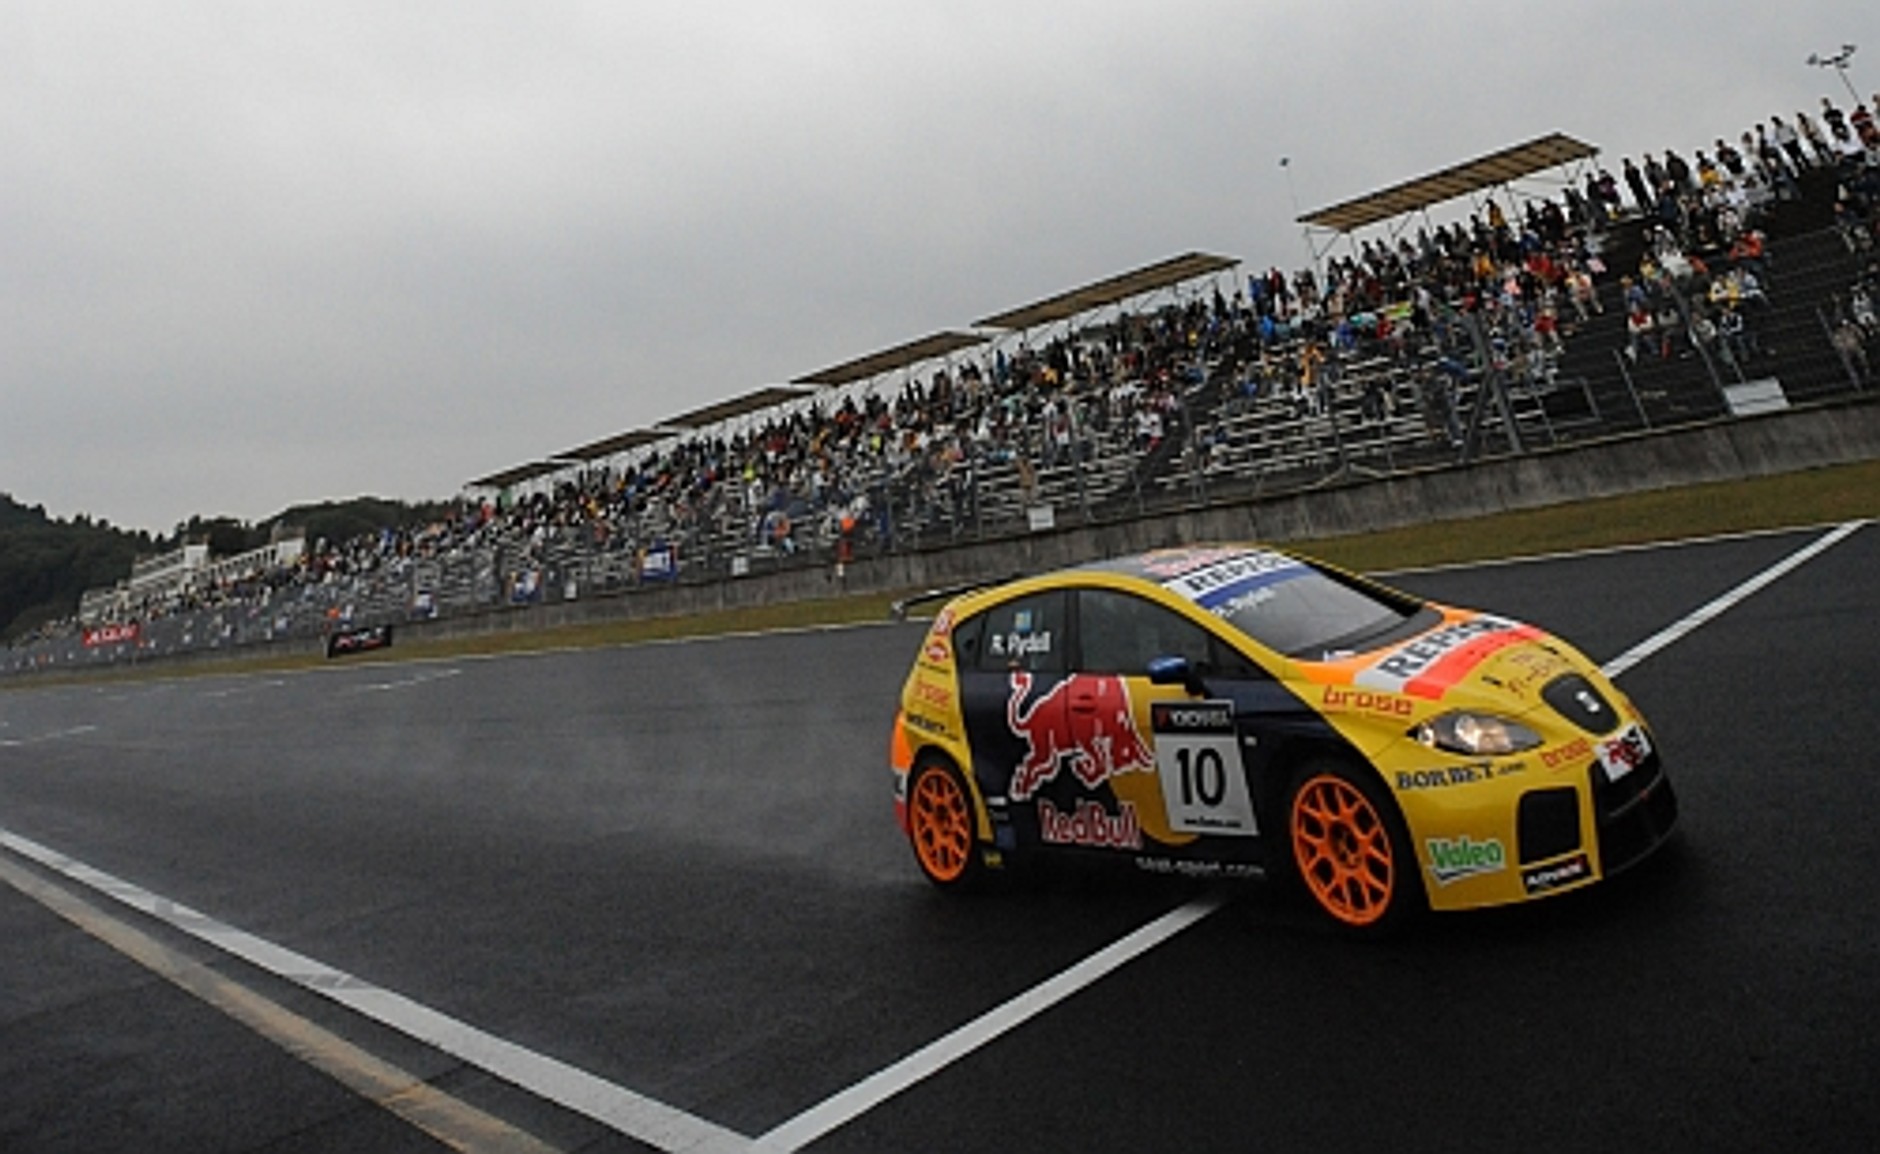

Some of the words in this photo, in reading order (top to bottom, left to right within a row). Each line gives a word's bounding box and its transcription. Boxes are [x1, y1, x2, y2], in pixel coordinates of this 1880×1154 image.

[1185, 556, 1289, 591] REP
[1323, 685, 1414, 716] brose
[1176, 747, 1227, 808] 10
[1398, 762, 1493, 789] BORBET
[1428, 836, 1503, 870] Valeo
